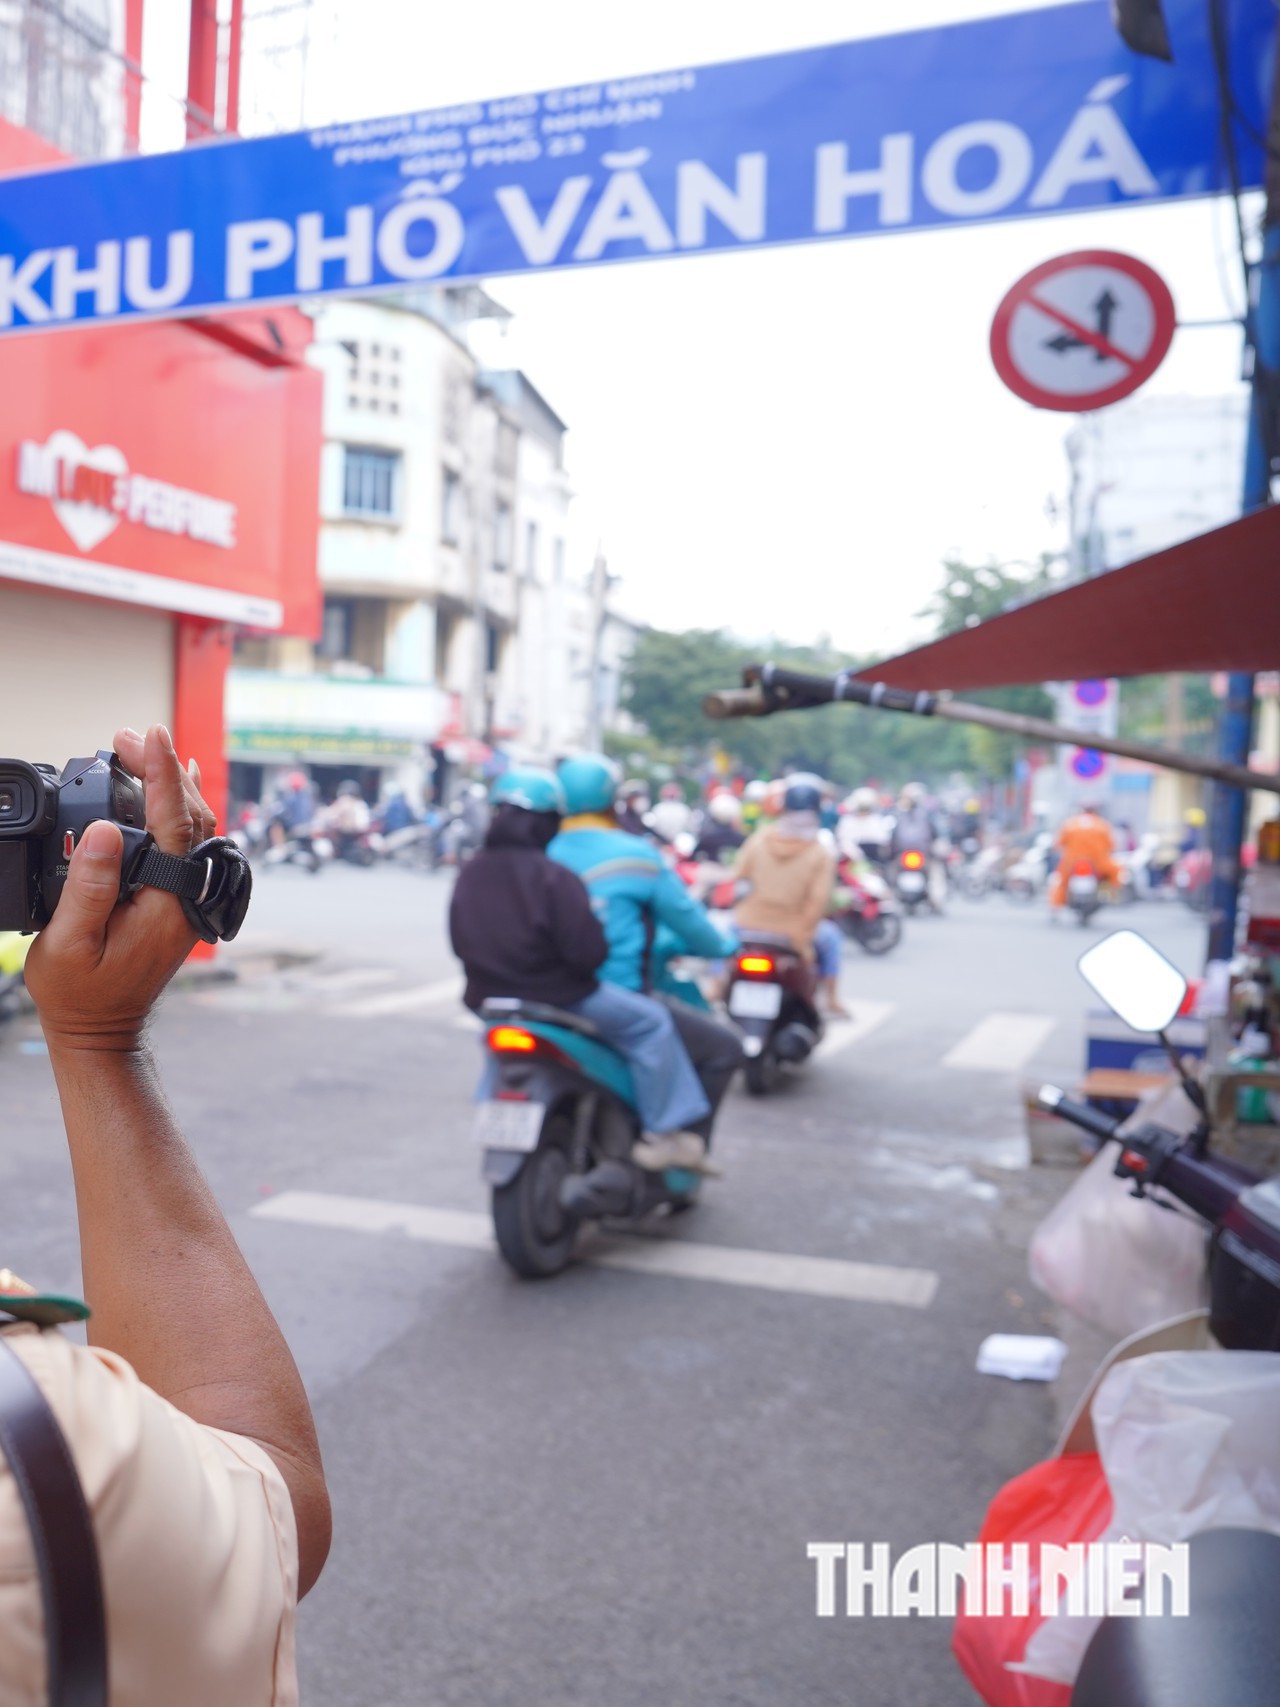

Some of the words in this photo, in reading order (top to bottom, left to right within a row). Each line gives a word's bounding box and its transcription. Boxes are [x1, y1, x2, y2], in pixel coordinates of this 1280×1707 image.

[224, 172, 466, 302] PHỐ
[494, 146, 768, 268] VĂN
[812, 73, 1161, 234] HOÁ
